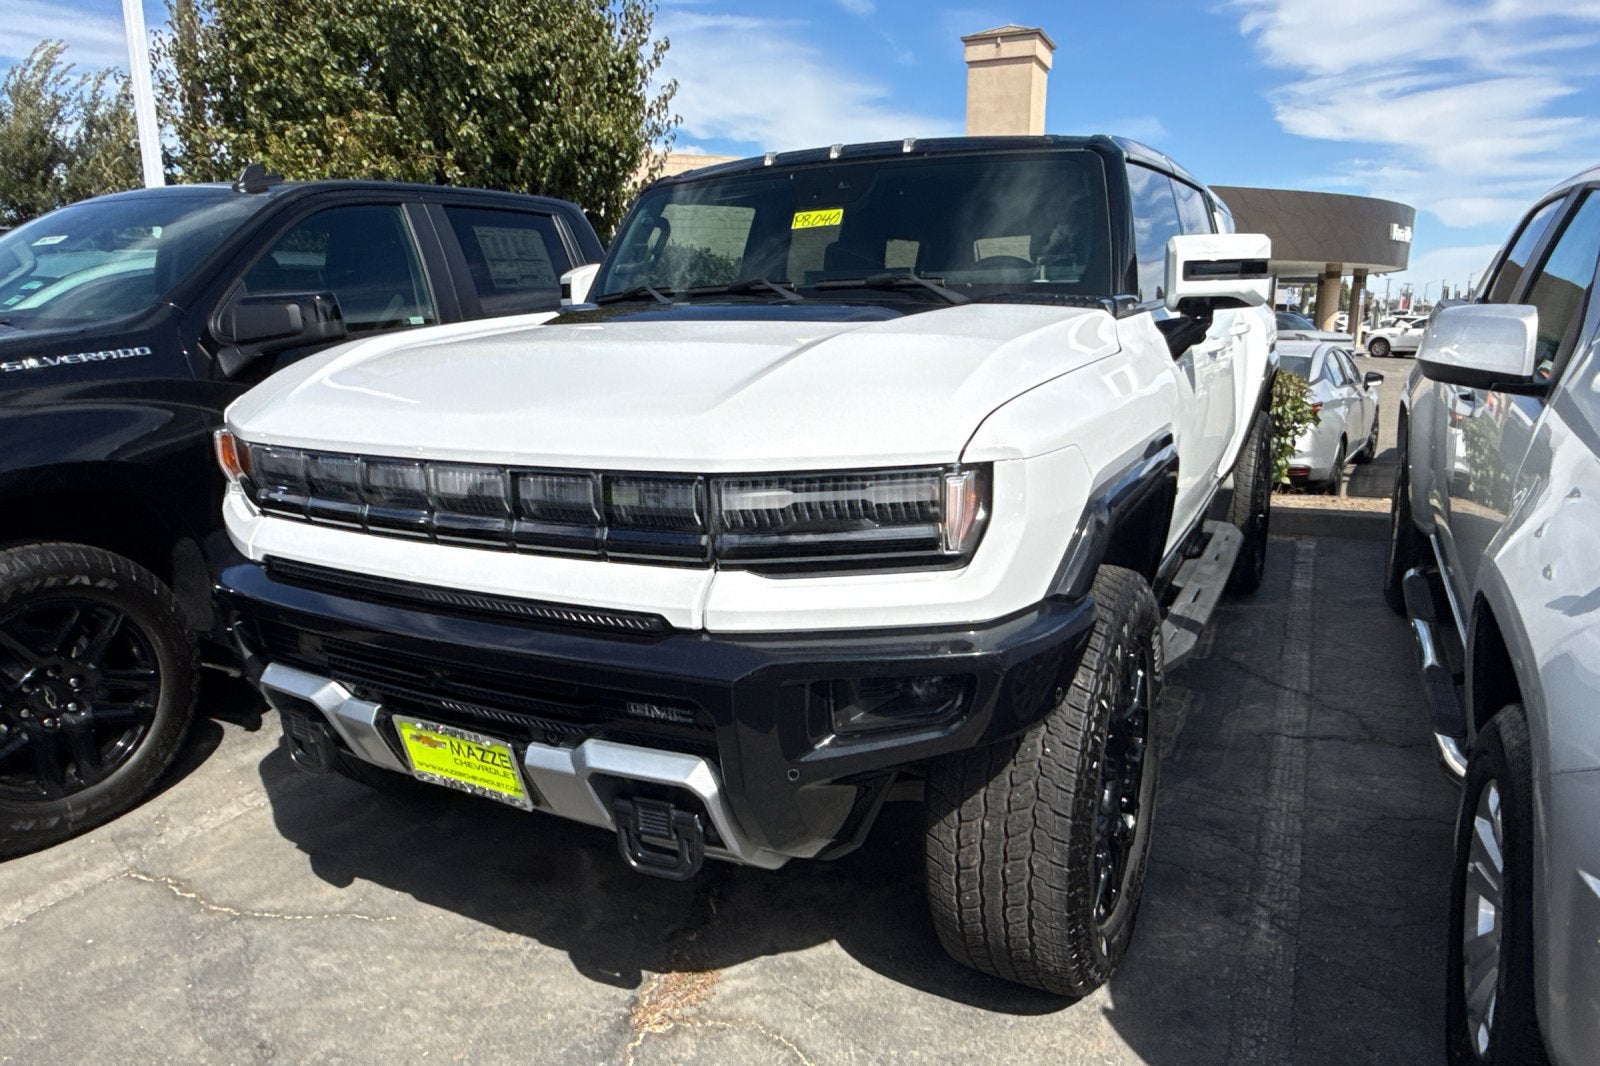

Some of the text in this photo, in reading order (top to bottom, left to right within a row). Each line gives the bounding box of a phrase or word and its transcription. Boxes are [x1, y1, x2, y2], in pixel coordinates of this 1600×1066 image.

[0, 346, 152, 372] SILVERADO
[627, 701, 694, 723] GMC
[449, 740, 514, 770] MAZZEI
[454, 757, 516, 779] CHEVROLET
